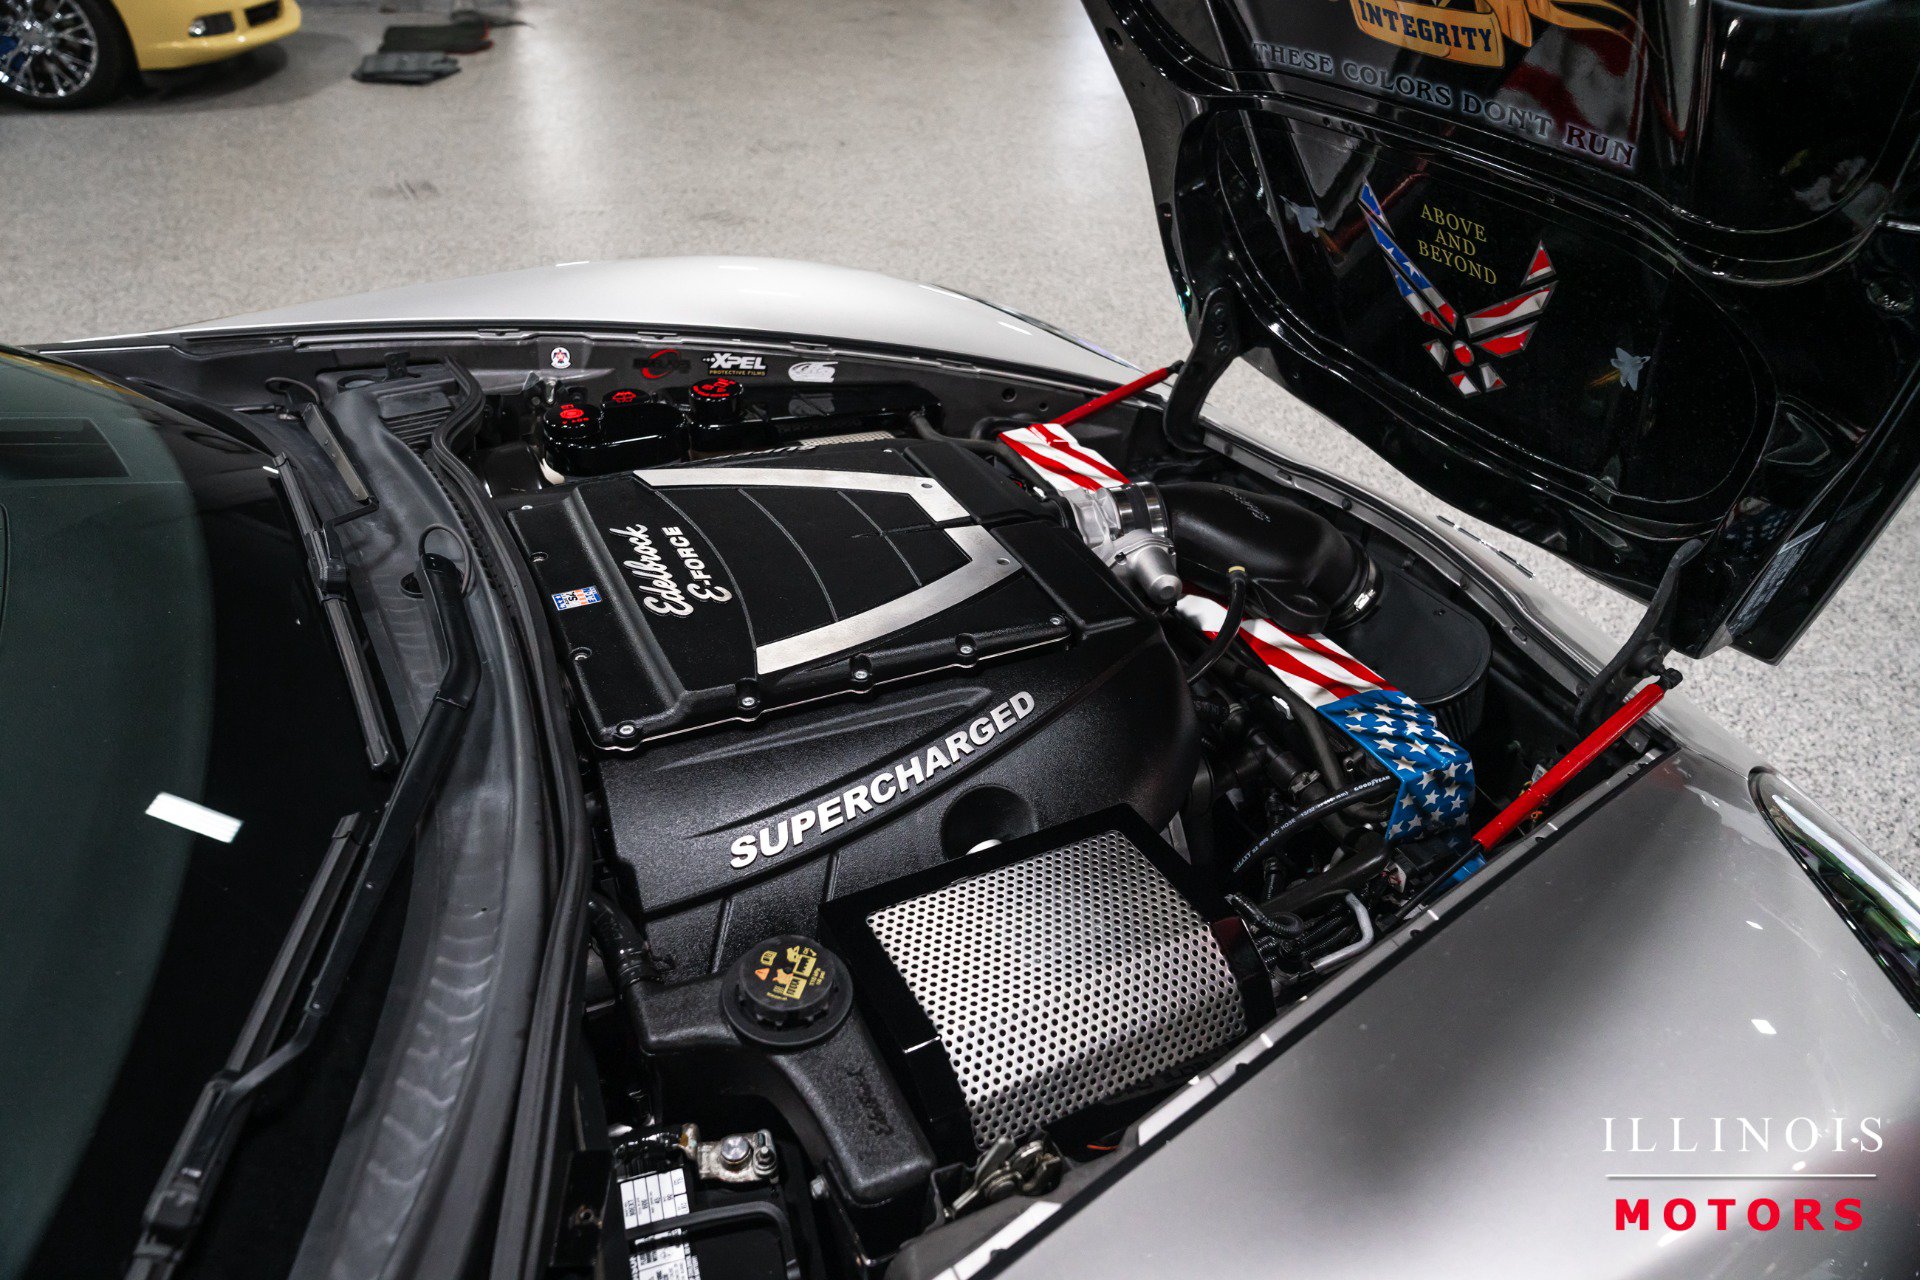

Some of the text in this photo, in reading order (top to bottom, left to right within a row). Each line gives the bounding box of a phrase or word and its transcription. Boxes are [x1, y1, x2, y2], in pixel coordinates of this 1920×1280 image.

[1358, 0, 1492, 52] INTEGRITY
[1253, 41, 1638, 168] THESE COLORS DON'T RUN
[1420, 203, 1488, 243] ABOVE
[1435, 228, 1477, 256] AND
[1417, 239, 1498, 285] BEYOND
[710, 352, 767, 370] XPEL
[610, 523, 695, 618] Edelbrock
[661, 526, 733, 604] E-FORCE
[729, 690, 1037, 870] SUPERCHARGED
[1353, 775, 1391, 792] GOODYEAR
